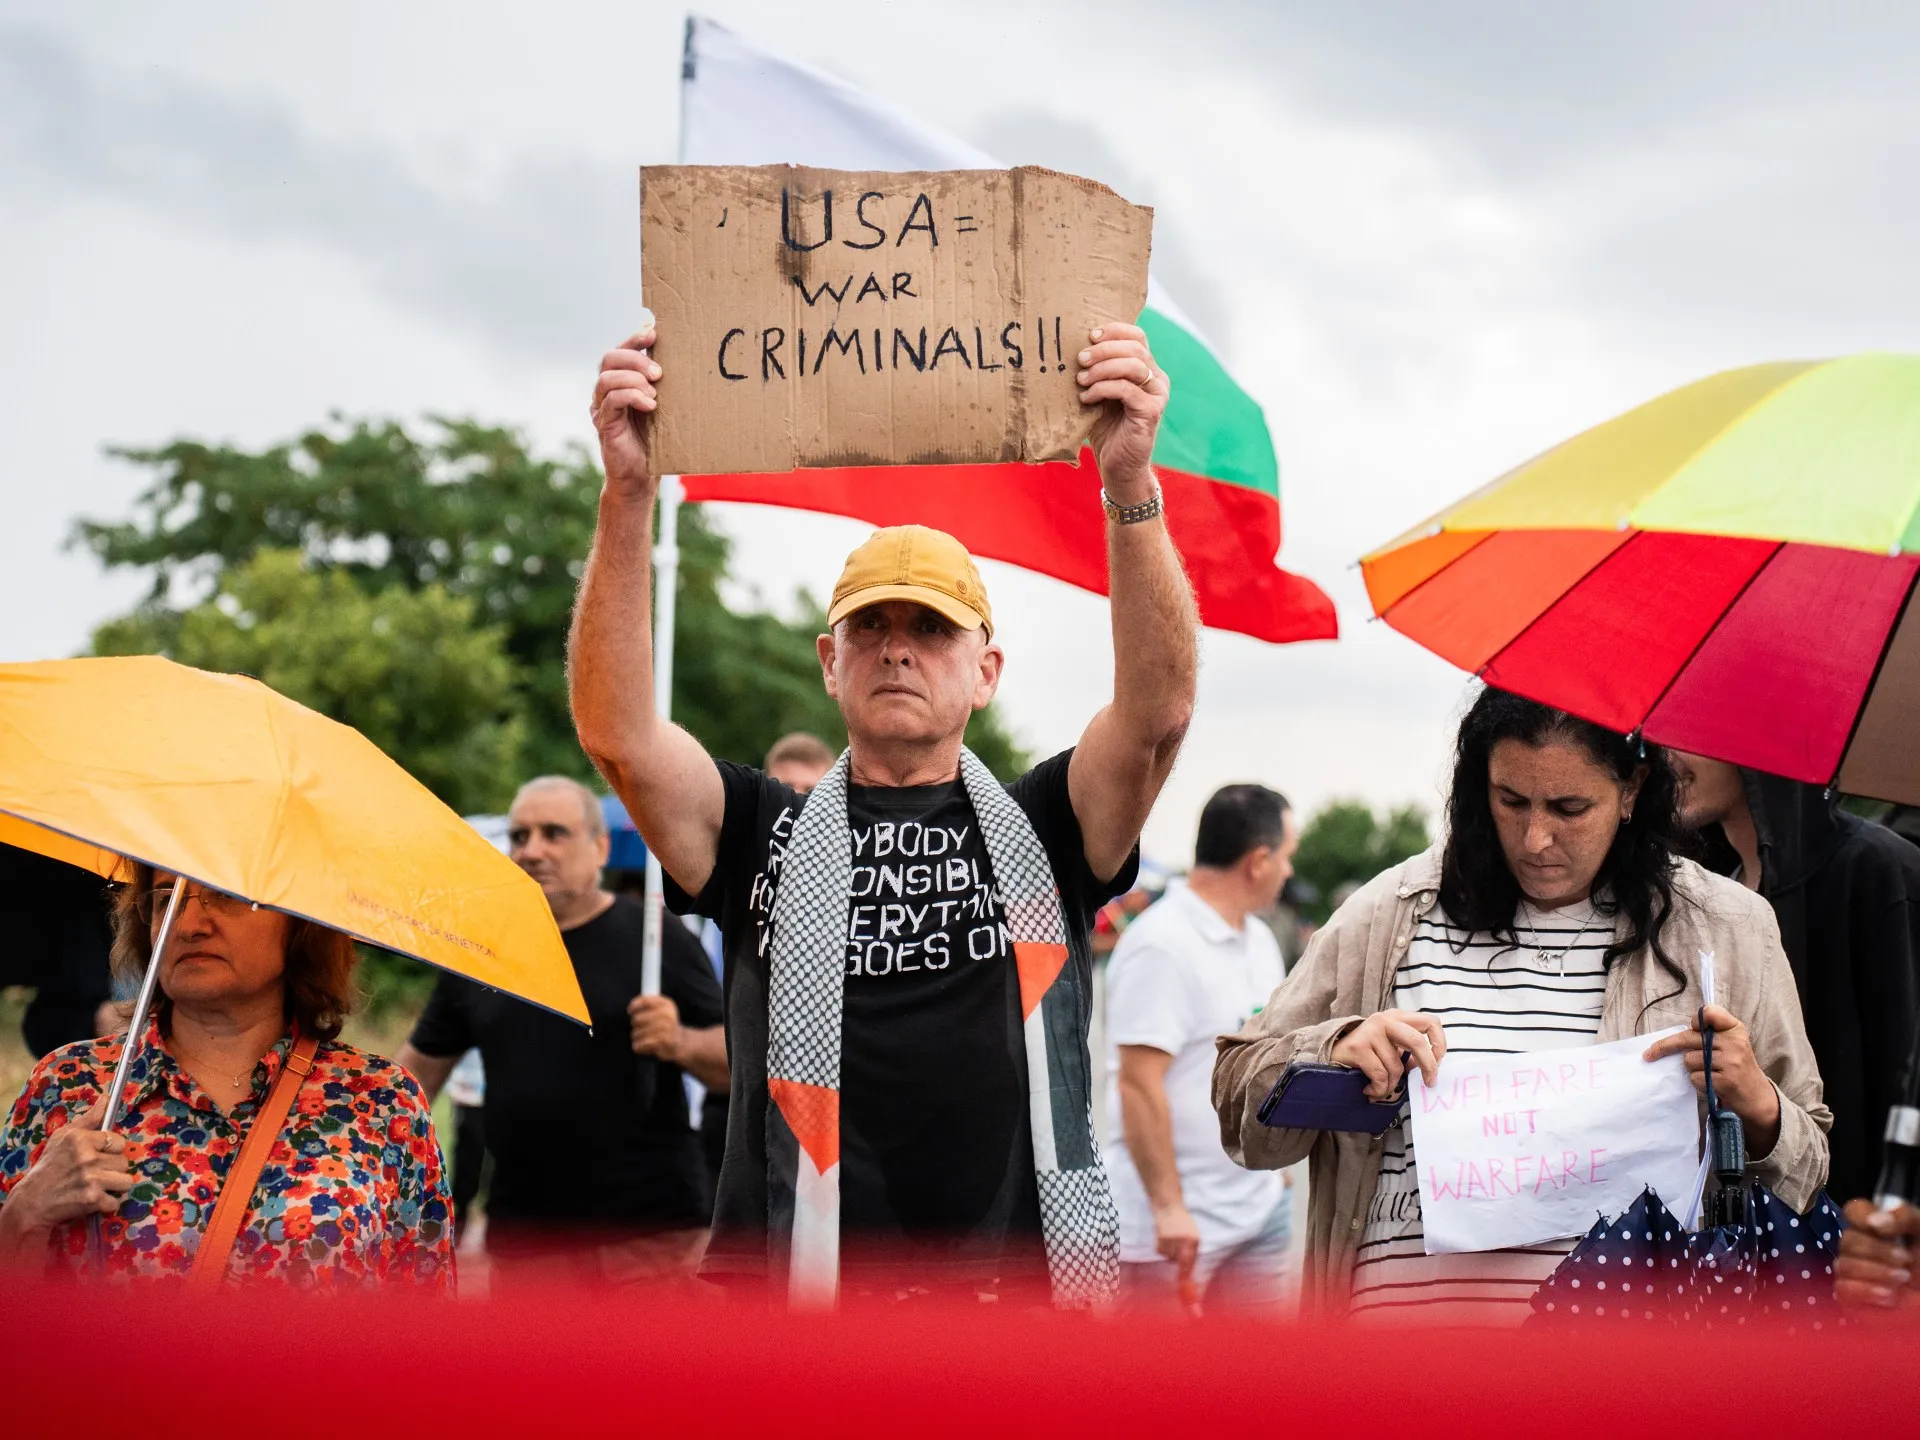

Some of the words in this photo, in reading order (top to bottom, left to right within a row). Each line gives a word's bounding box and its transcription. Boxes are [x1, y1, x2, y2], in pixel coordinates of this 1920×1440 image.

[793, 272, 918, 306] WAR
[718, 316, 1066, 381] CRIMINALS!!
[444, 931, 498, 959] BENETTON
[1420, 1058, 1609, 1113] WELFARE
[1482, 1109, 1540, 1138] NOT
[1430, 1149, 1608, 1201] WARFARE
